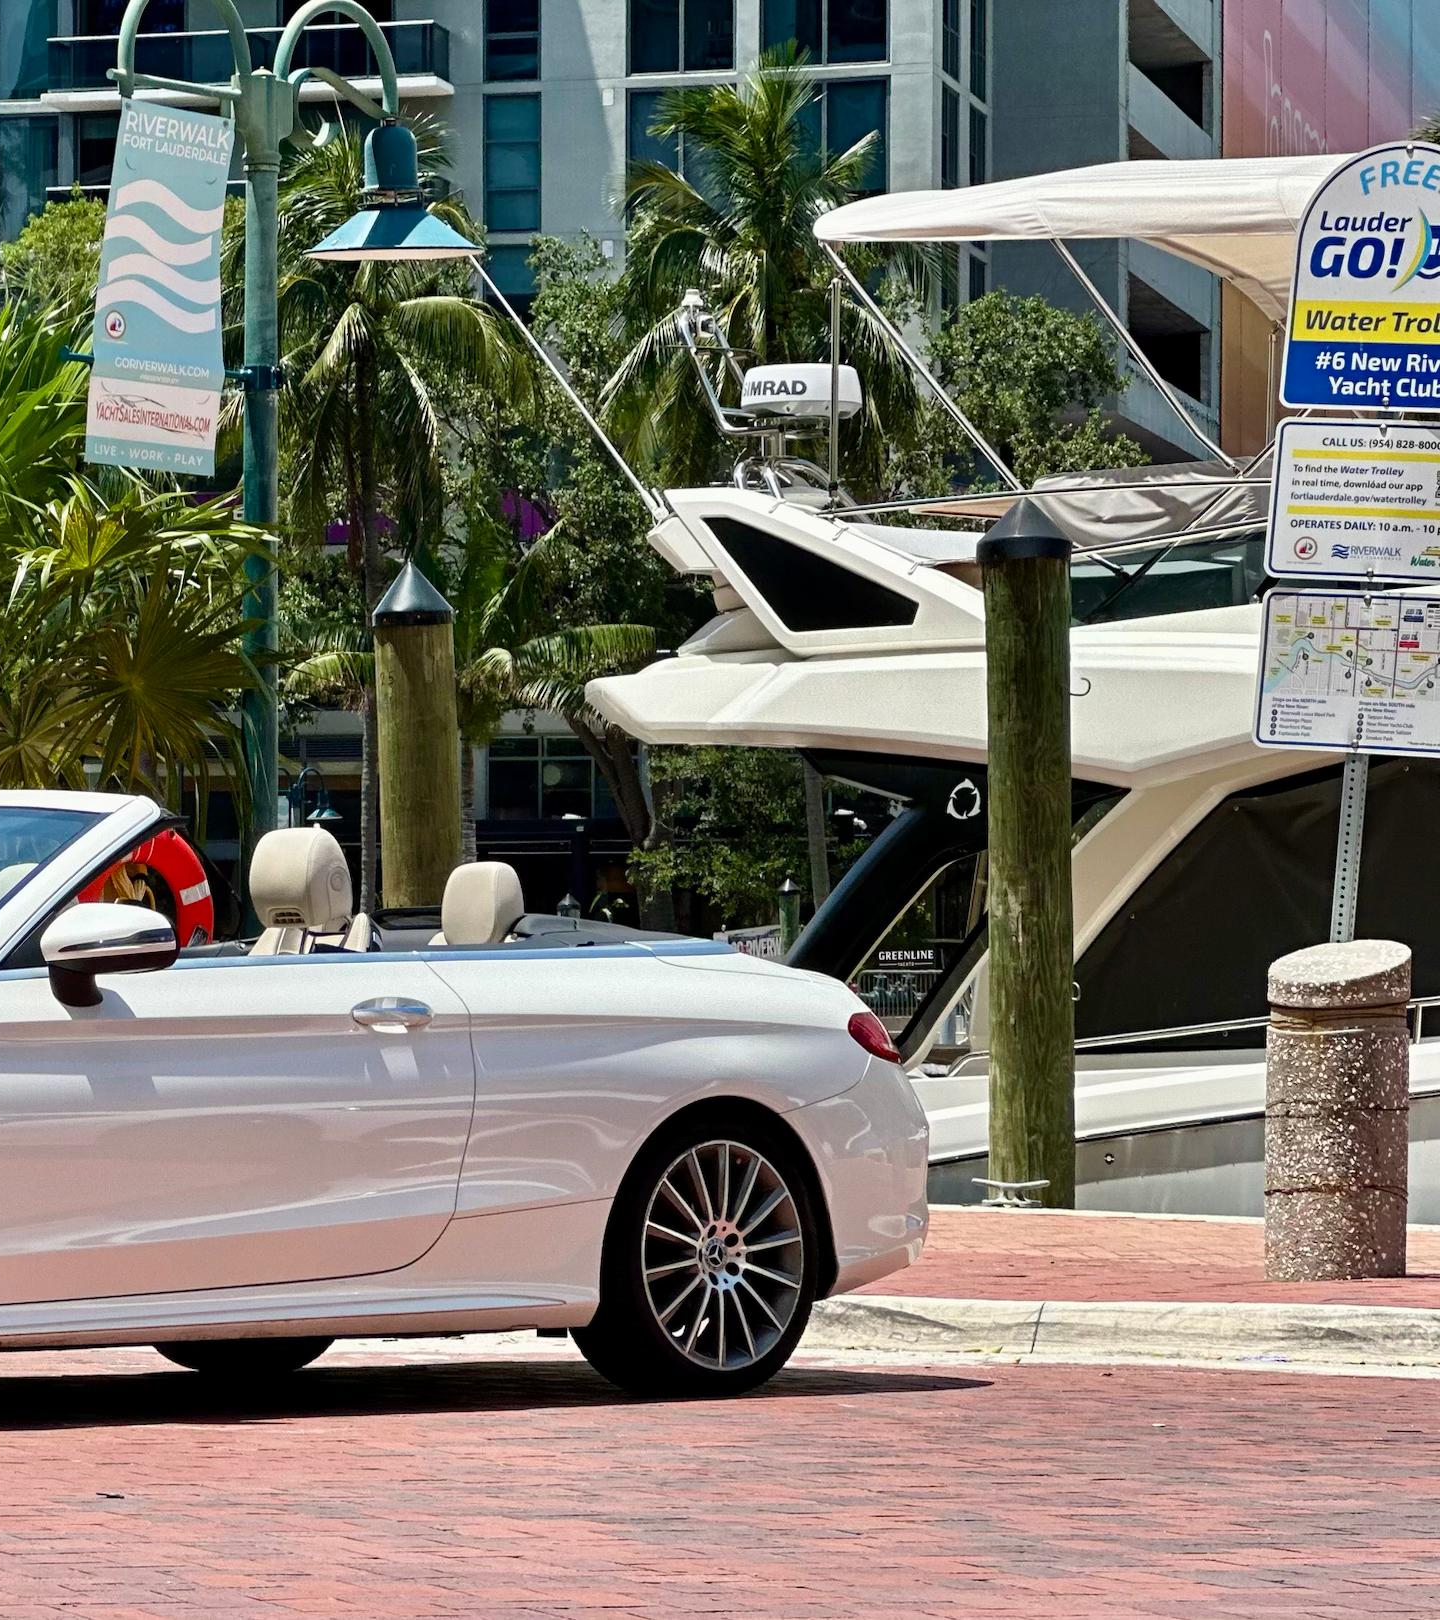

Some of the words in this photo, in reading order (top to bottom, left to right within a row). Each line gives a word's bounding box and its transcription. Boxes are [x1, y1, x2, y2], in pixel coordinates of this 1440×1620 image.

[125, 111, 230, 151] RIVERWALK
[122, 134, 152, 150] FORT
[155, 140, 228, 166] LAUDERDALE
[1359, 160, 1440, 196] FREE
[1320, 211, 1412, 232] Lauder
[1310, 236, 1405, 278] GO!
[1306, 310, 1386, 332] Water
[114, 356, 210, 378] GORIVERWALK.COM
[1315, 352, 1346, 370] #6
[1351, 352, 1400, 372] New
[1406, 354, 1440, 374] Riv
[743, 380, 807, 397] SIMRAD
[1329, 376, 1390, 397] Yacht
[1322, 437, 1347, 446] CALL
[1350, 438, 1366, 448] US:
[1369, 438, 1394, 450] (954)
[94, 444, 117, 456] LIVE
[129, 448, 164, 463] WORK
[174, 453, 204, 467] PLAY
[1294, 464, 1303, 472] To
[1305, 464, 1322, 473] find
[1324, 465, 1338, 474] the
[1340, 466, 1370, 475] Water
[1371, 466, 1404, 477] Trolley
[1292, 478, 1300, 486] in
[1302, 478, 1318, 487] real
[1320, 479, 1342, 489] time,
[1344, 480, 1386, 490] download
[1388, 482, 1404, 490] our
[1405, 483, 1423, 492] app
[1290, 492, 1427, 506] fortlauderdale.gov/watertrolley
[1290, 519, 1342, 530] OPERATES
[1344, 520, 1376, 531] DAILY:
[1379, 522, 1390, 532] 10
[1392, 524, 1414, 532] a.m.
[1423, 524, 1435, 534] 10
[1350, 544, 1402, 556] RIVERWALK
[878, 950, 934, 960] GREENLINE
